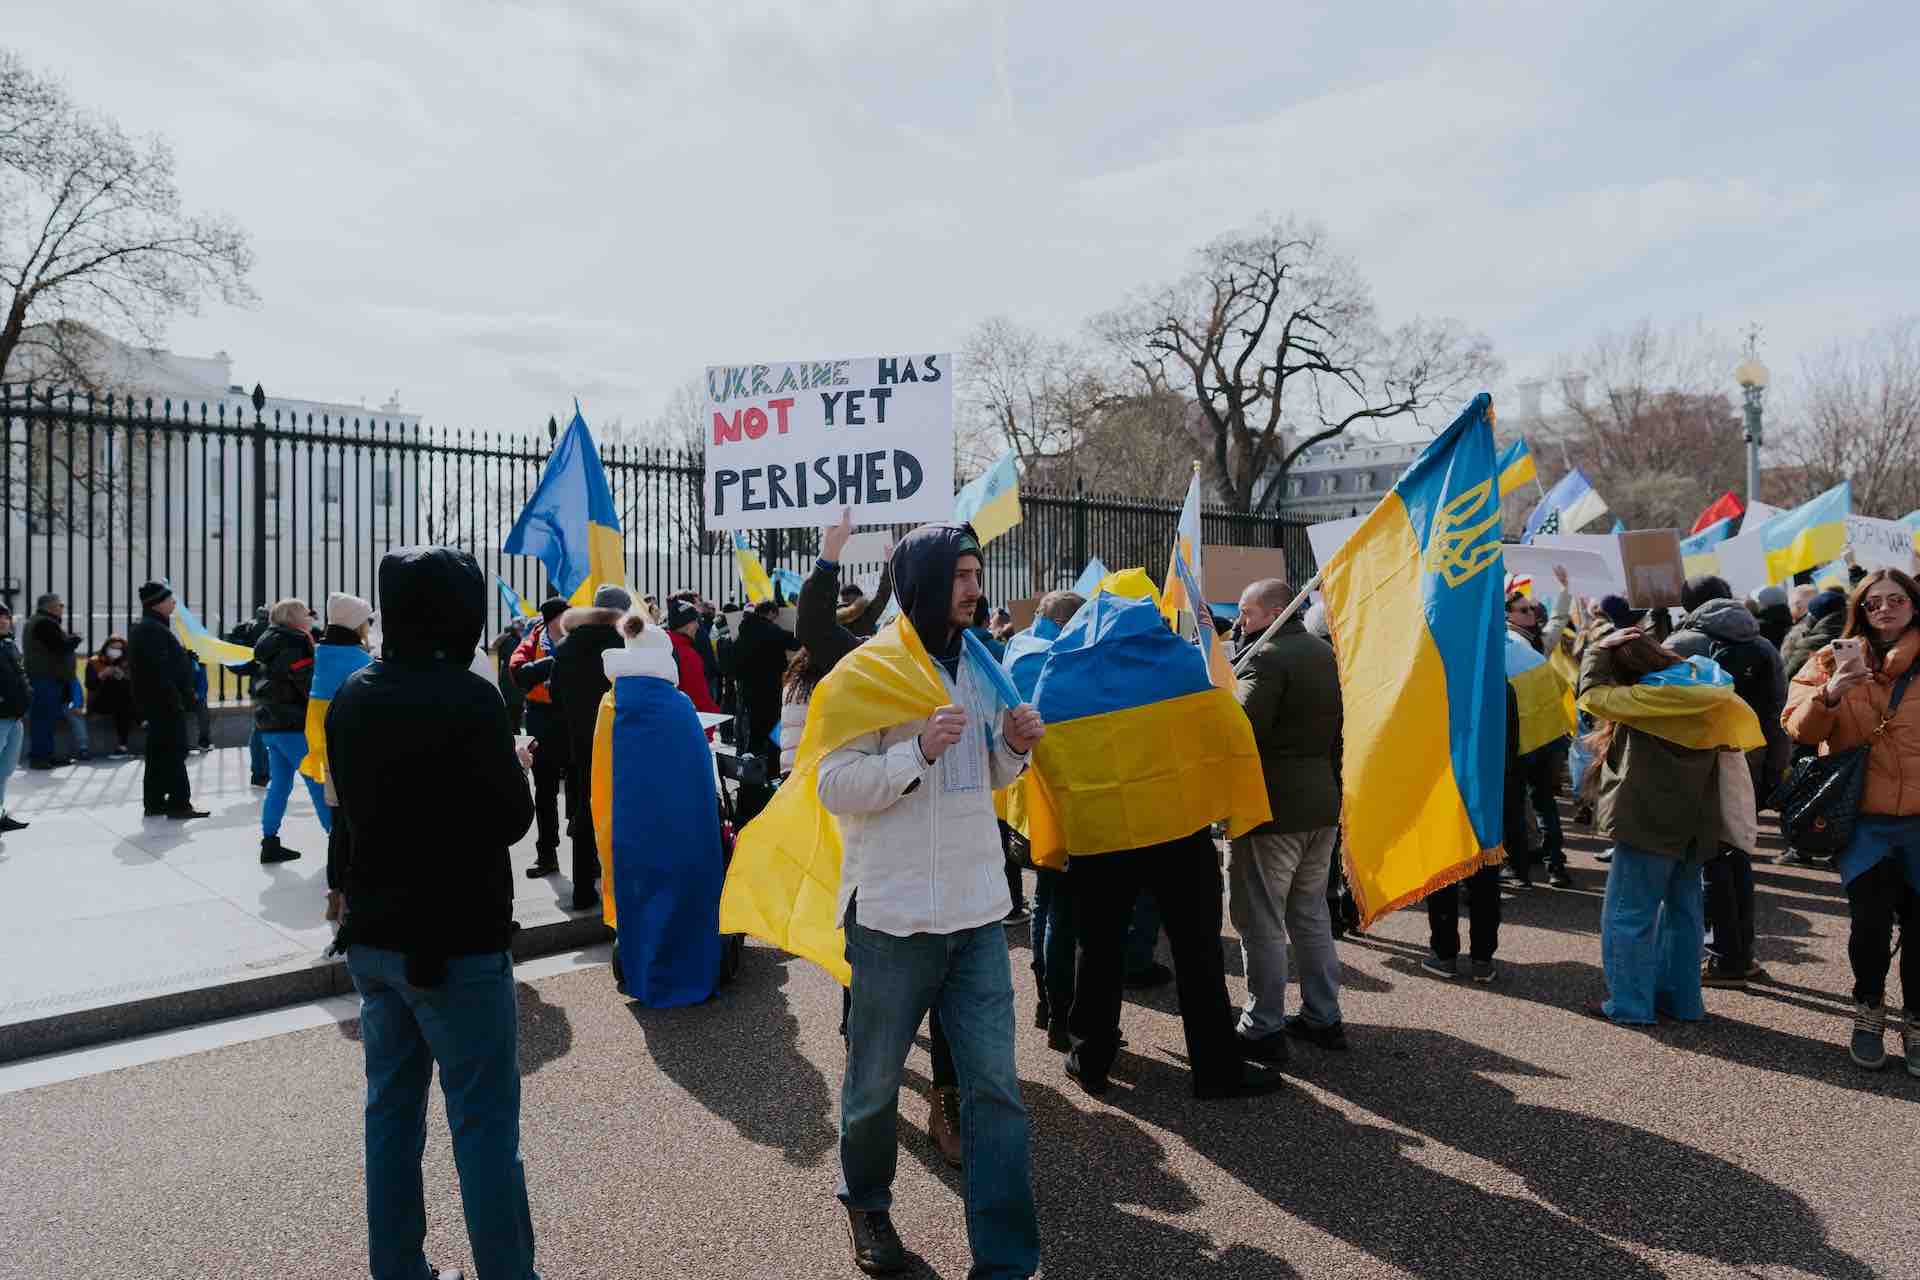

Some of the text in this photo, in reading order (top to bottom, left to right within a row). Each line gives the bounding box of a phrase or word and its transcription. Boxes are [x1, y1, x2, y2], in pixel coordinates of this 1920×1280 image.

[708, 355, 942, 402] UKRAINE HAS
[713, 388, 892, 446] NOT YET
[714, 449, 924, 516] PERISHED
